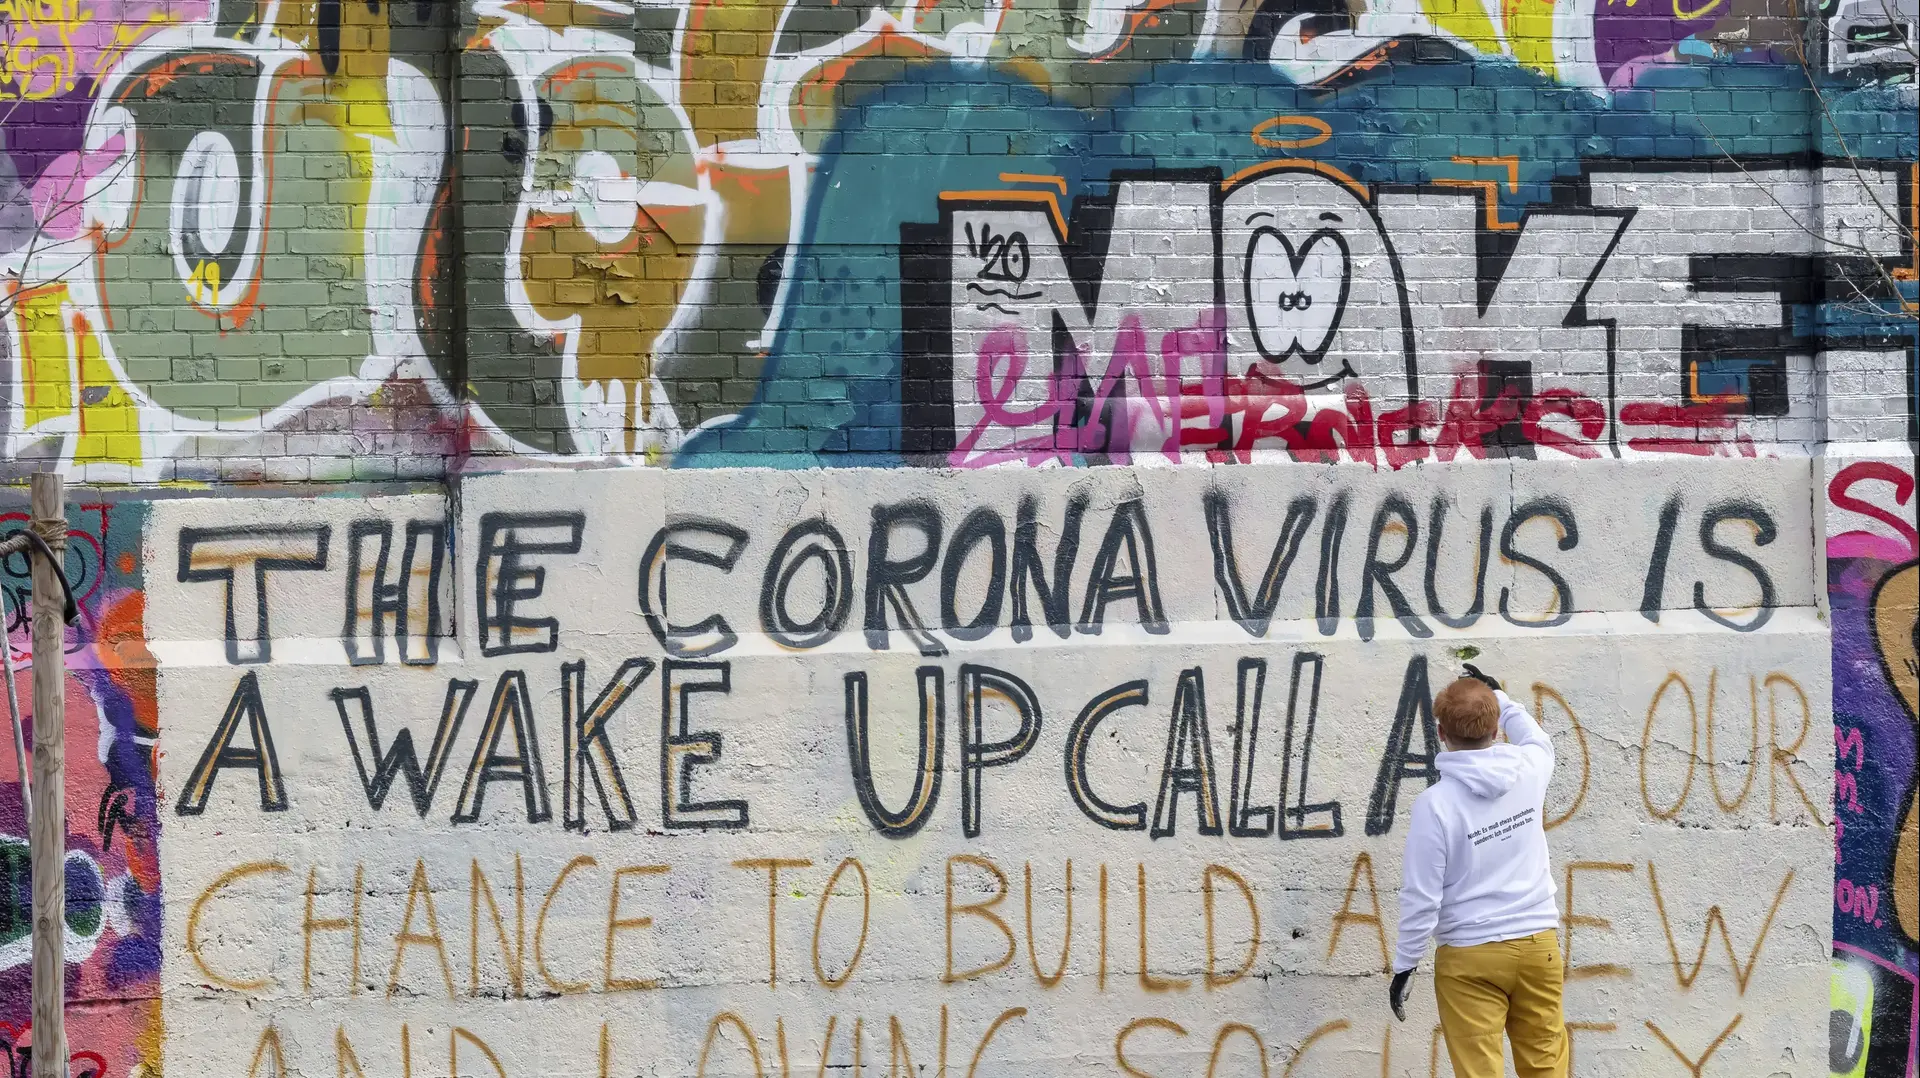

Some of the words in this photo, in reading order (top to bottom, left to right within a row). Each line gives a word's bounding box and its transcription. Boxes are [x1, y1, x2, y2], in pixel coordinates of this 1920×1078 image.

[177, 510, 586, 667] THE
[638, 494, 1169, 657] CORONA
[1201, 487, 1579, 641] VIRUS
[1639, 492, 1778, 632] IS
[175, 670, 290, 817] A
[328, 657, 748, 832] WAKE
[844, 663, 1042, 840] UP
[1064, 652, 1344, 839] CALL
[1364, 654, 1591, 836] AD
[1639, 667, 1828, 827] OUR
[186, 851, 673, 1001] CHANCE
[731, 856, 870, 990] TO
[940, 853, 1262, 993] BUILD
[1324, 851, 1392, 974] A
[1562, 860, 1797, 997] EW
